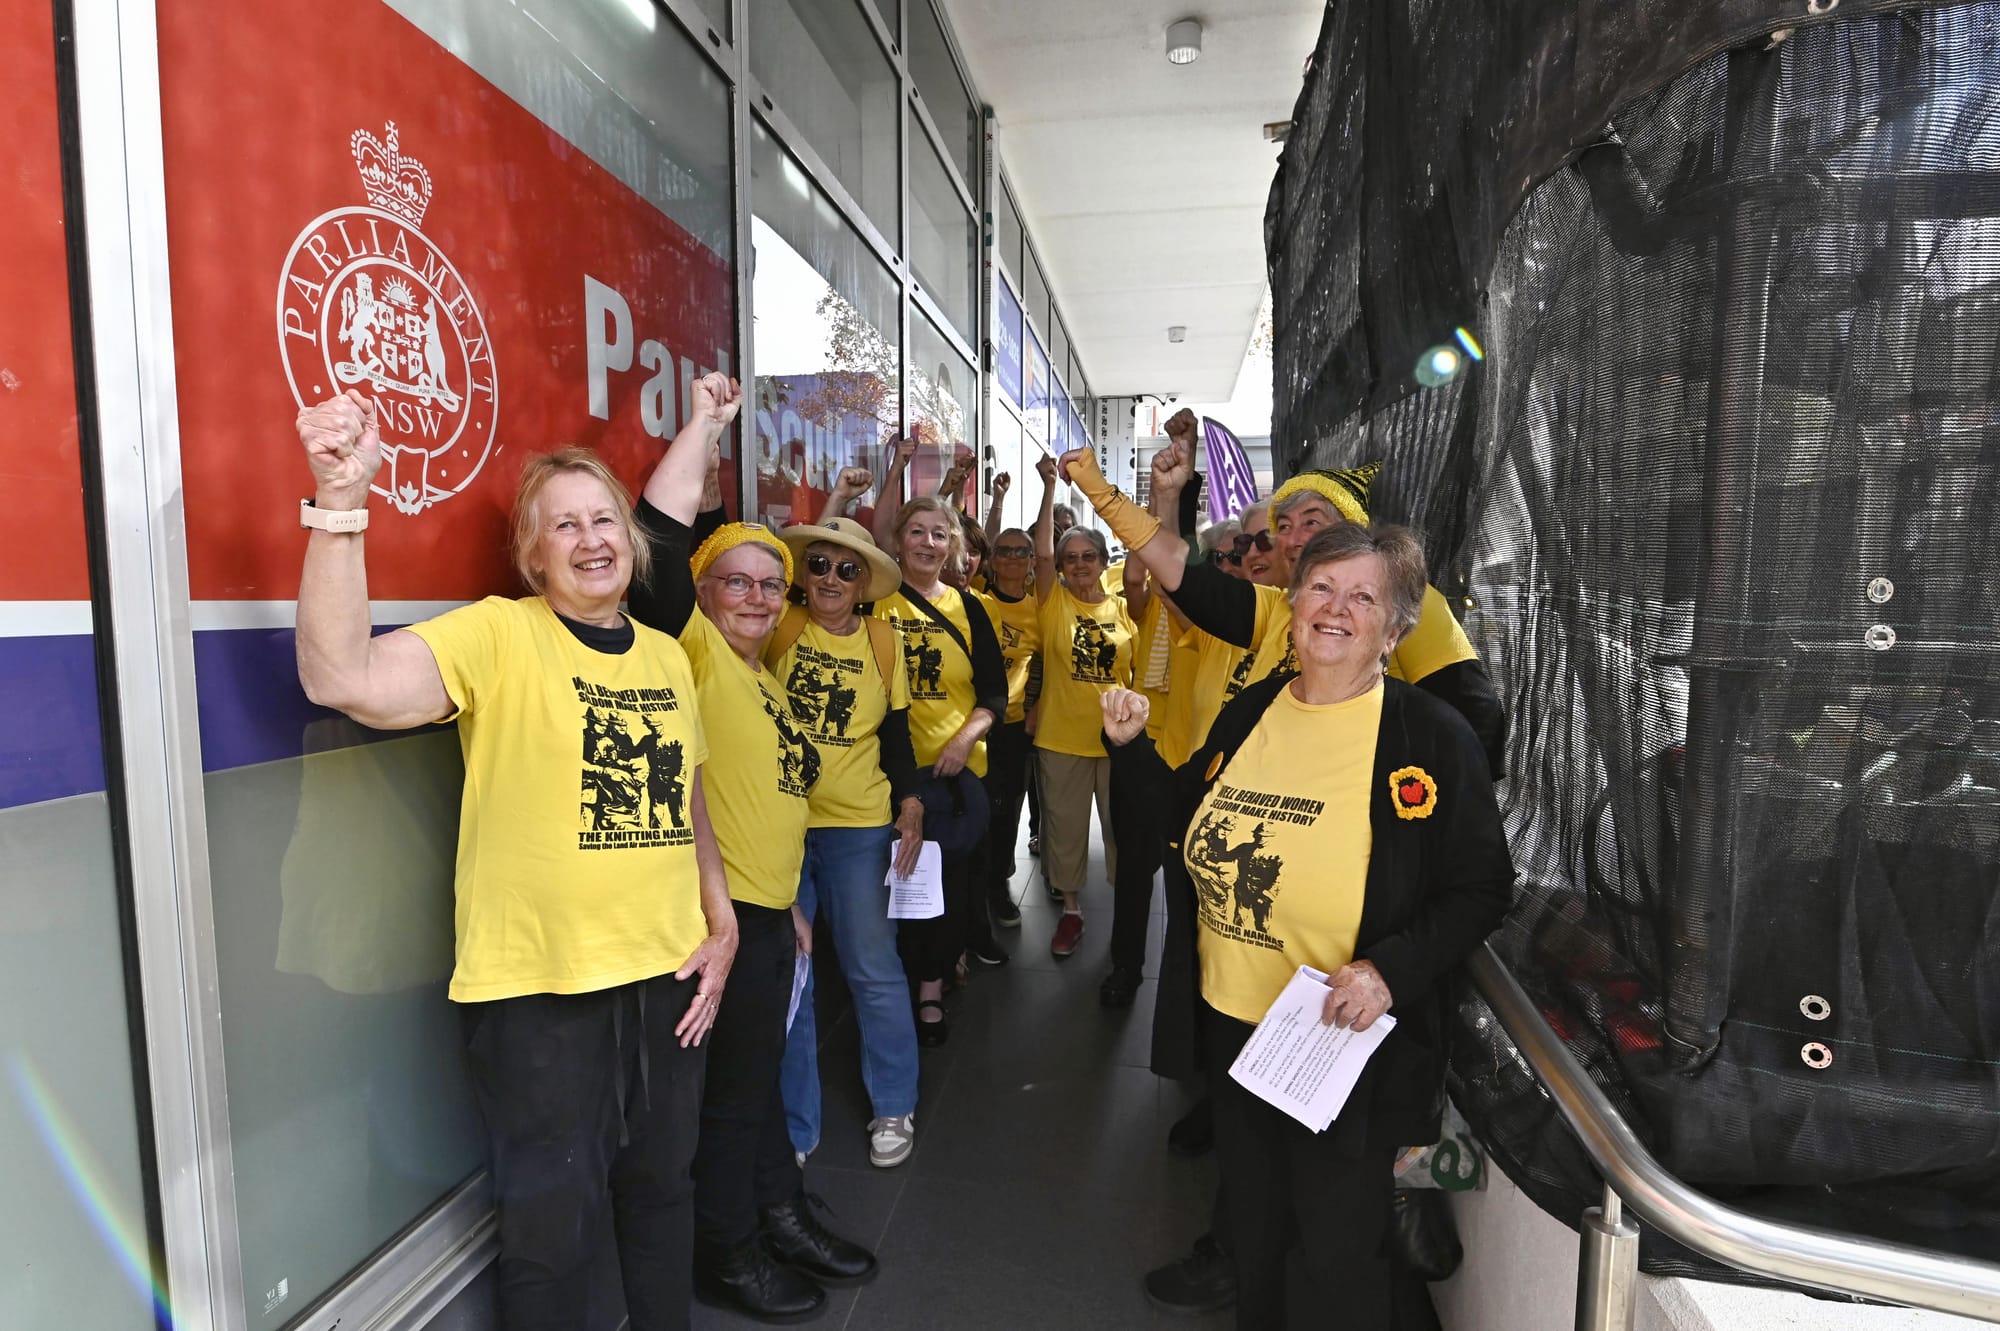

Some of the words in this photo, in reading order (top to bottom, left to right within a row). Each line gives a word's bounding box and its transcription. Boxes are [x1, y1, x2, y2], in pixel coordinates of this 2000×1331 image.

[284, 218, 495, 403] PARLIAMENT
[373, 394, 444, 440] NSW
[637, 688, 676, 702] WOMEN
[639, 701, 679, 712] HISTORY
[1217, 785, 1238, 800] WELL
[1235, 789, 1281, 808] BEHAVED
[1279, 796, 1325, 815] WOMEN
[1239, 804, 1269, 819] MAKE
[1267, 810, 1317, 826] HISTORY
[578, 832, 602, 842] THE
[604, 830, 660, 842] KNITTING
[1243, 929, 1284, 949] NANNAS
